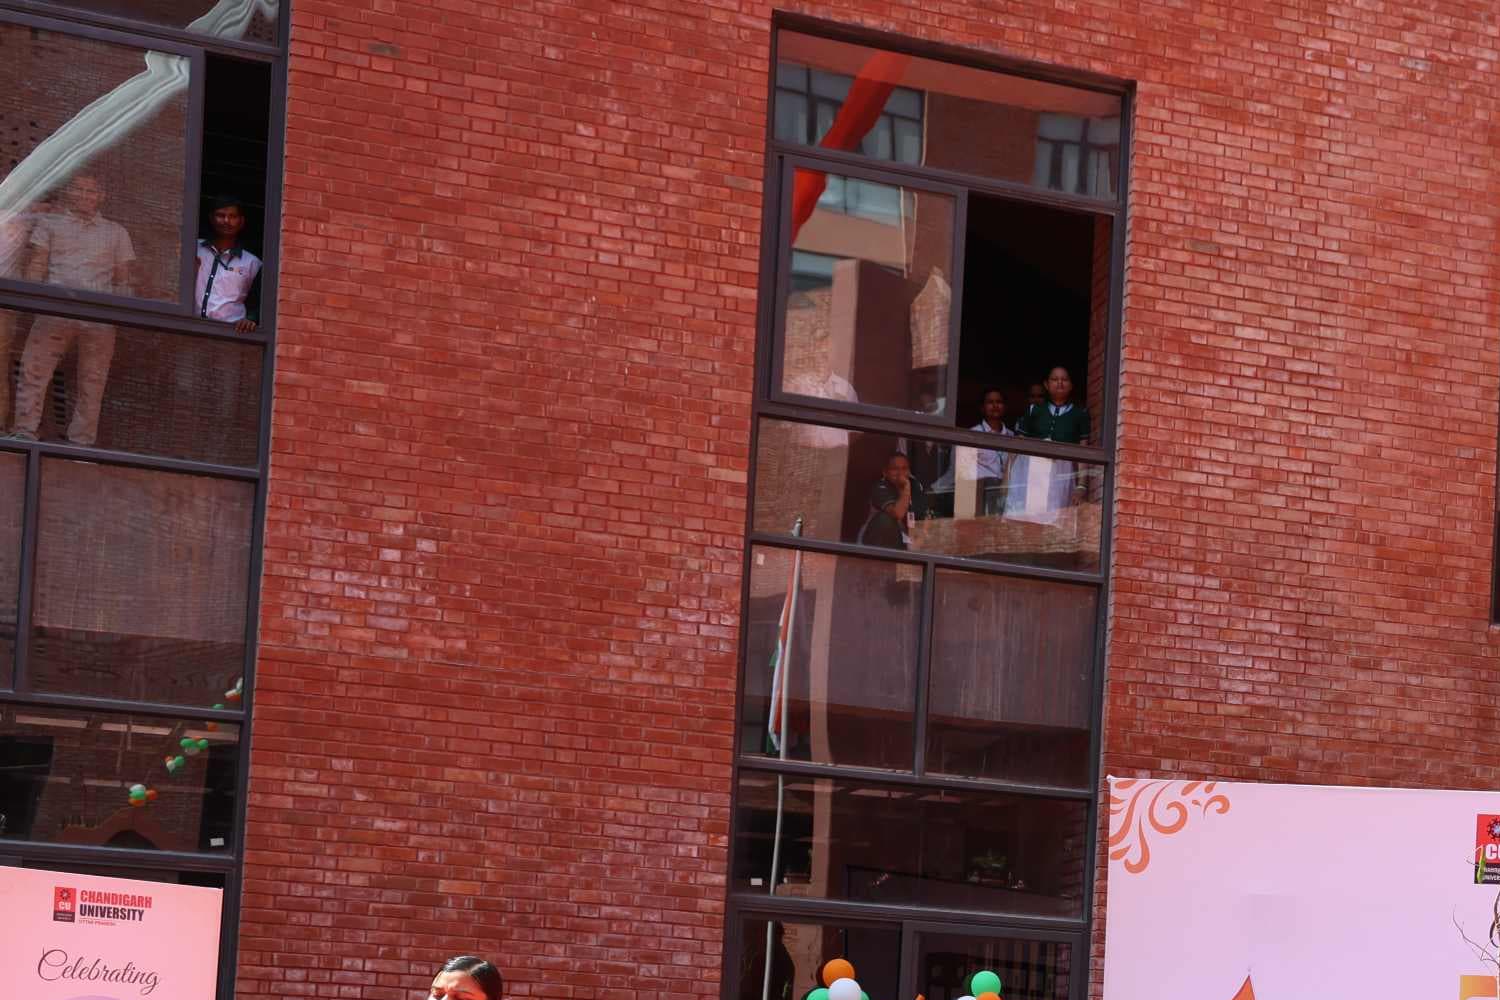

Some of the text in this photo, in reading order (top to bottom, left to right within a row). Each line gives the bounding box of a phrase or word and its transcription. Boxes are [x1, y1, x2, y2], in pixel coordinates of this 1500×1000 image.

[80, 889, 153, 909] CHANDIGARH
[79, 903, 145, 922] UNIVERSITY
[37, 947, 160, 995] Celebrating
